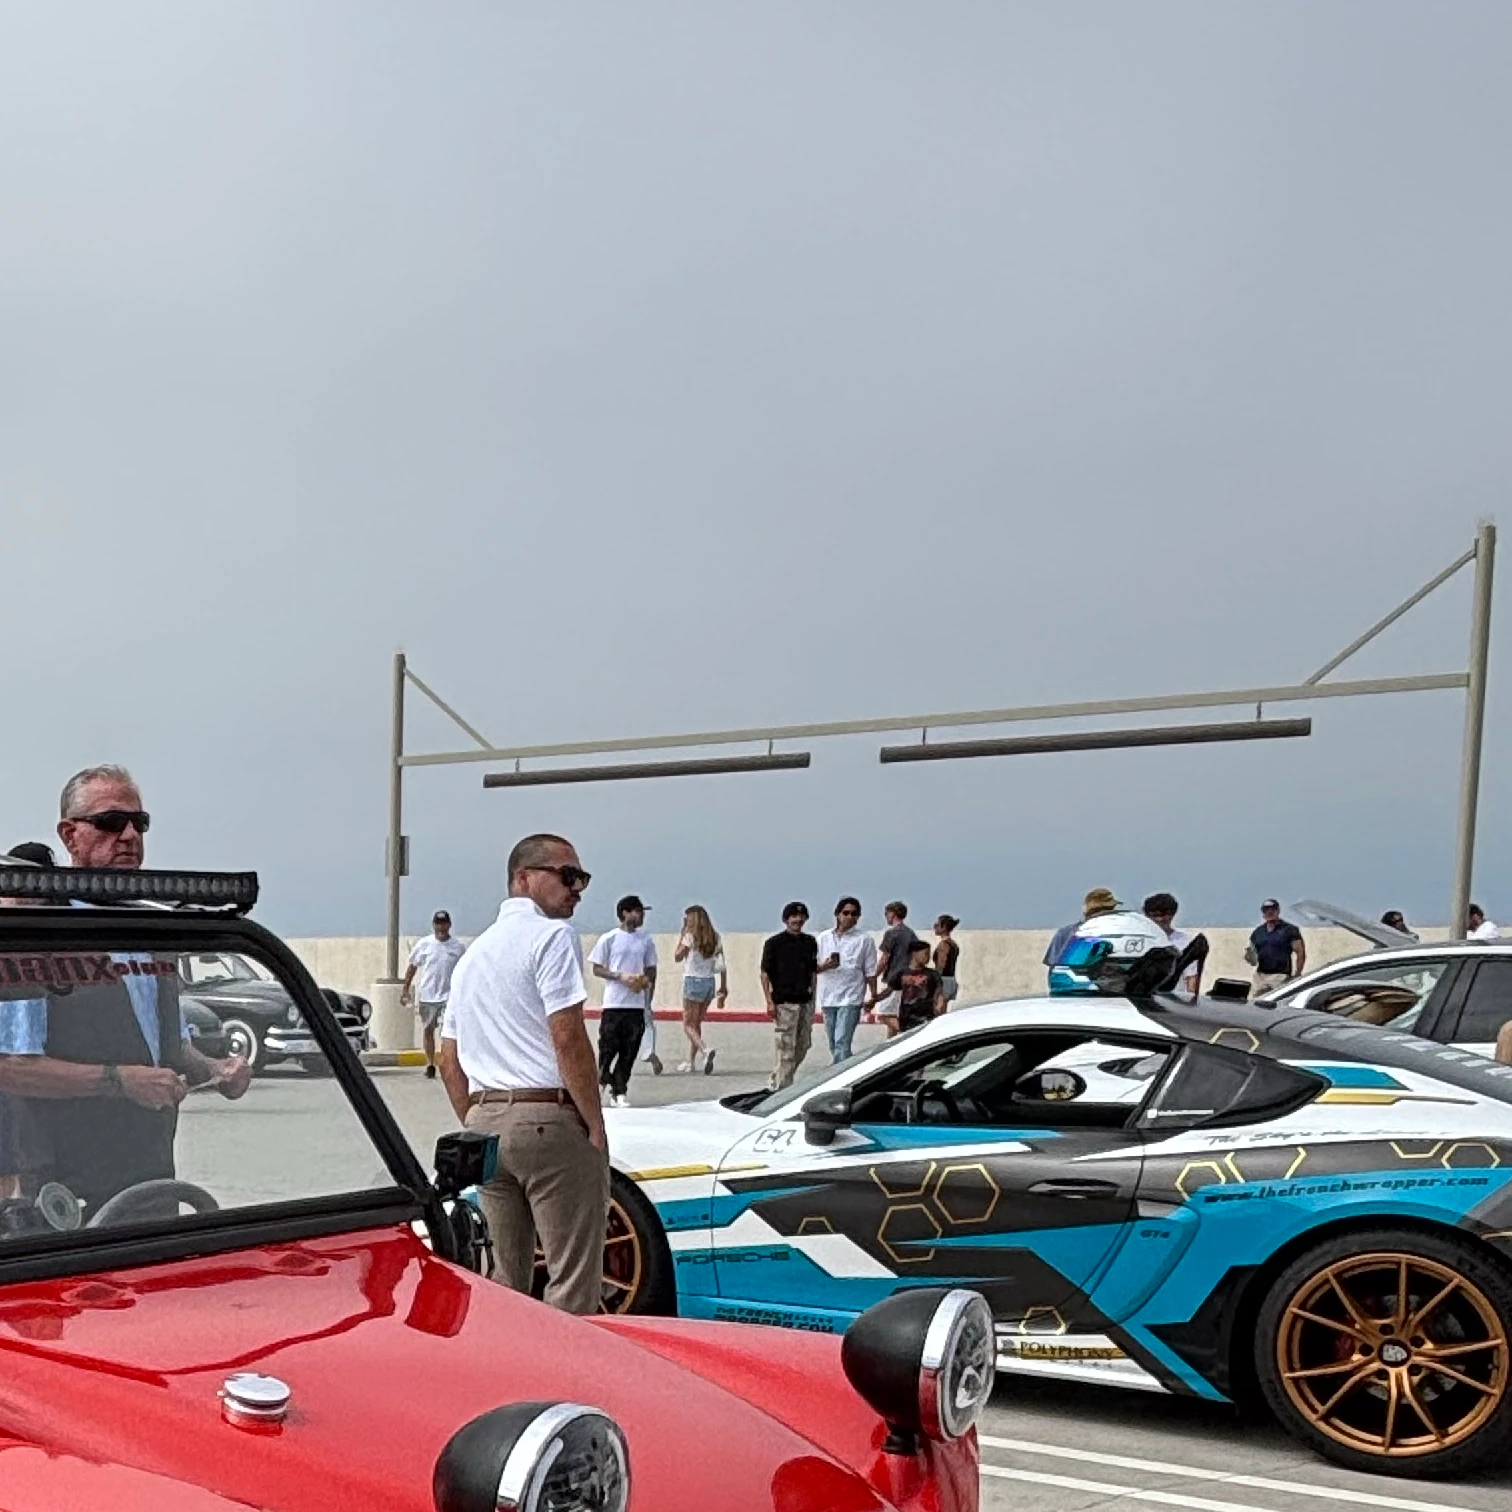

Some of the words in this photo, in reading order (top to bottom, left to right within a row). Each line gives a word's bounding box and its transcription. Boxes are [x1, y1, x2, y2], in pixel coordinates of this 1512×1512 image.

[1203, 1176, 1489, 1203] www.thefrenchwrapper.com
[1140, 1229, 1170, 1239] GT4
[675, 1251, 790, 1266] PORSCHE
[737, 1307, 793, 1321] FRENCH
[1020, 1340, 1114, 1361] POLYPHONY
